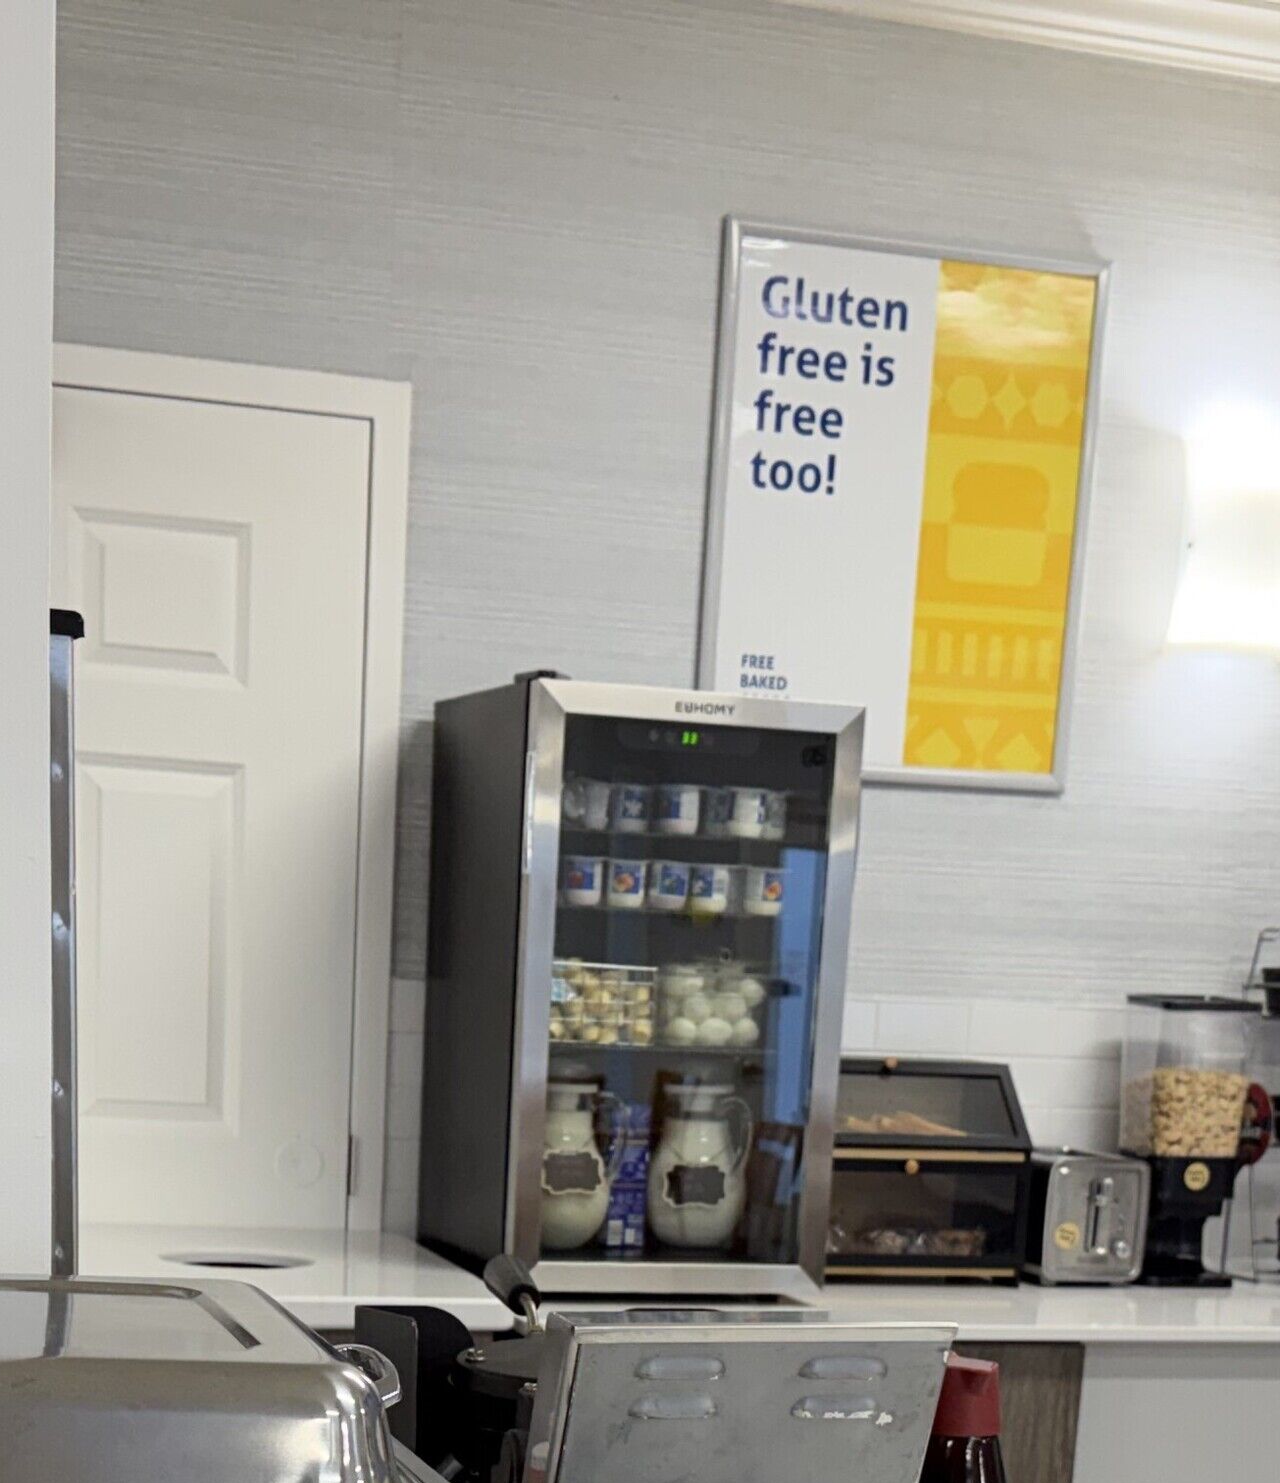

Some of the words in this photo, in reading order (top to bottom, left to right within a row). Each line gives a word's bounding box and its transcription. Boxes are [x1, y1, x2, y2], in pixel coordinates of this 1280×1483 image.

[761, 275, 908, 332] Gluten
[757, 331, 847, 382] free
[860, 342, 895, 387] is
[754, 389, 843, 438] free
[751, 451, 836, 495] too!
[740, 674, 788, 690] BAKED
[741, 654, 774, 670] FREE
[675, 701, 736, 715] EUHOMY
